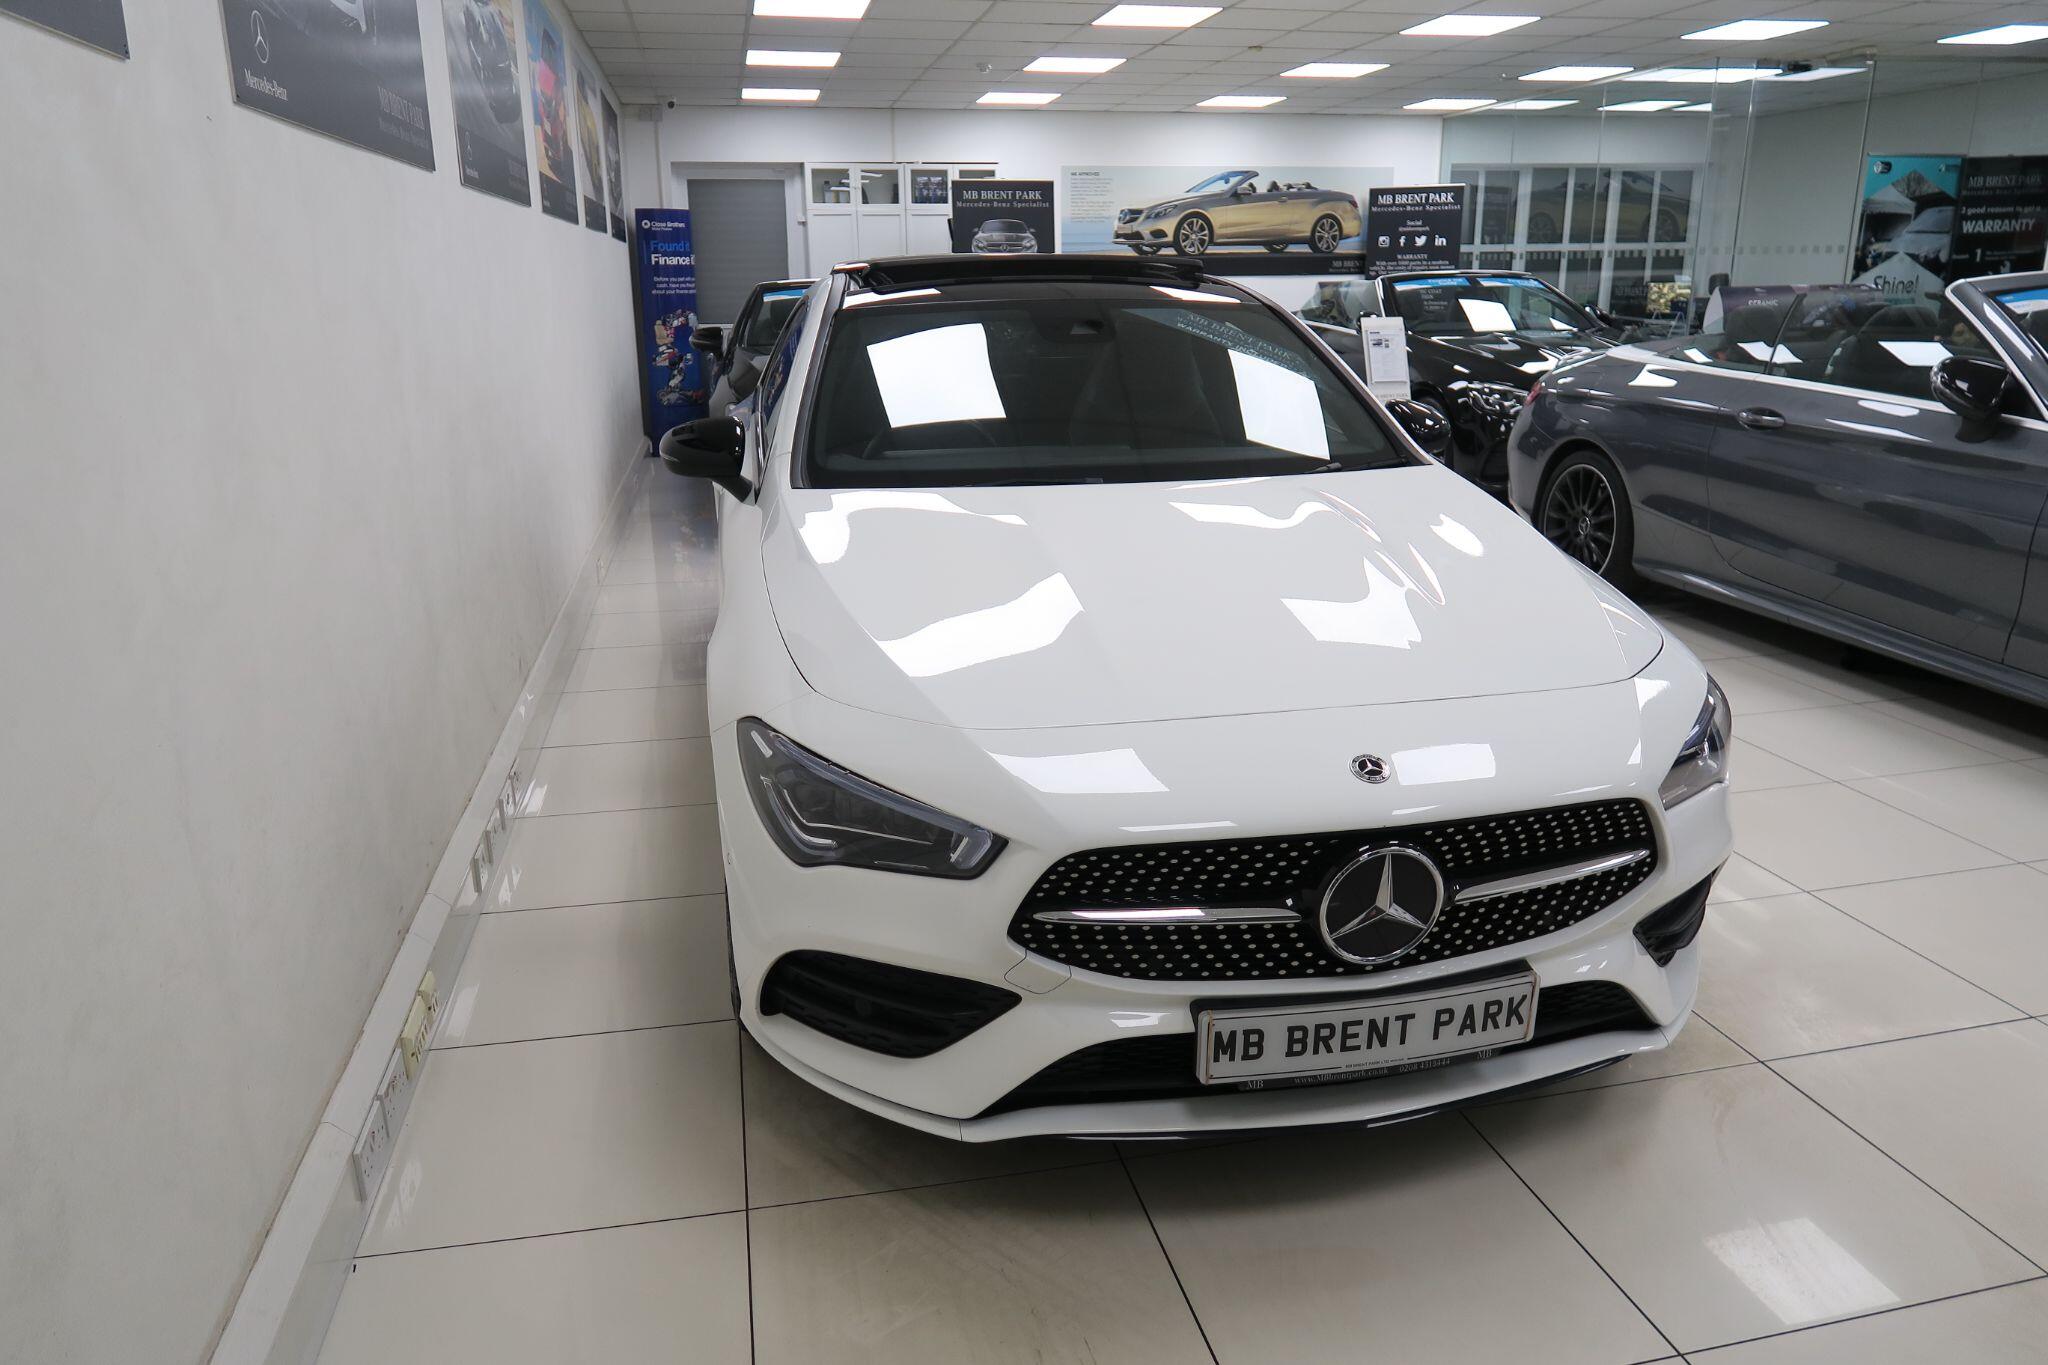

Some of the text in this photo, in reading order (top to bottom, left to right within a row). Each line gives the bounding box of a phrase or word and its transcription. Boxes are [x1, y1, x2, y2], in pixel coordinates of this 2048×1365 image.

[243, 66, 289, 101] Mercedes-Benz
[1968, 175, 2042, 186] MB BRENT PARK
[962, 190, 1042, 200] MB BRENT PARK
[1377, 192, 1455, 204] MB BRENT PARK
[1967, 204, 1986, 216] good
[1961, 218, 2036, 234] WARRANTY
[651, 240, 684, 251] Found
[651, 254, 690, 265] Finance
[1975, 249, 1982, 262] 1
[1331, 260, 1343, 268] MB
[1874, 274, 1919, 294] Shine!
[1176, 322, 1233, 347] WARRANTY
[1210, 322, 1253, 342] BRENT
[1256, 341, 1291, 360] PARK
[1212, 993, 1528, 1064] MB BRENT PARK
[1476, 1048, 1493, 1060] MB
[1399, 1062, 1418, 1073] 0208
[1246, 1079, 1265, 1090] MB
